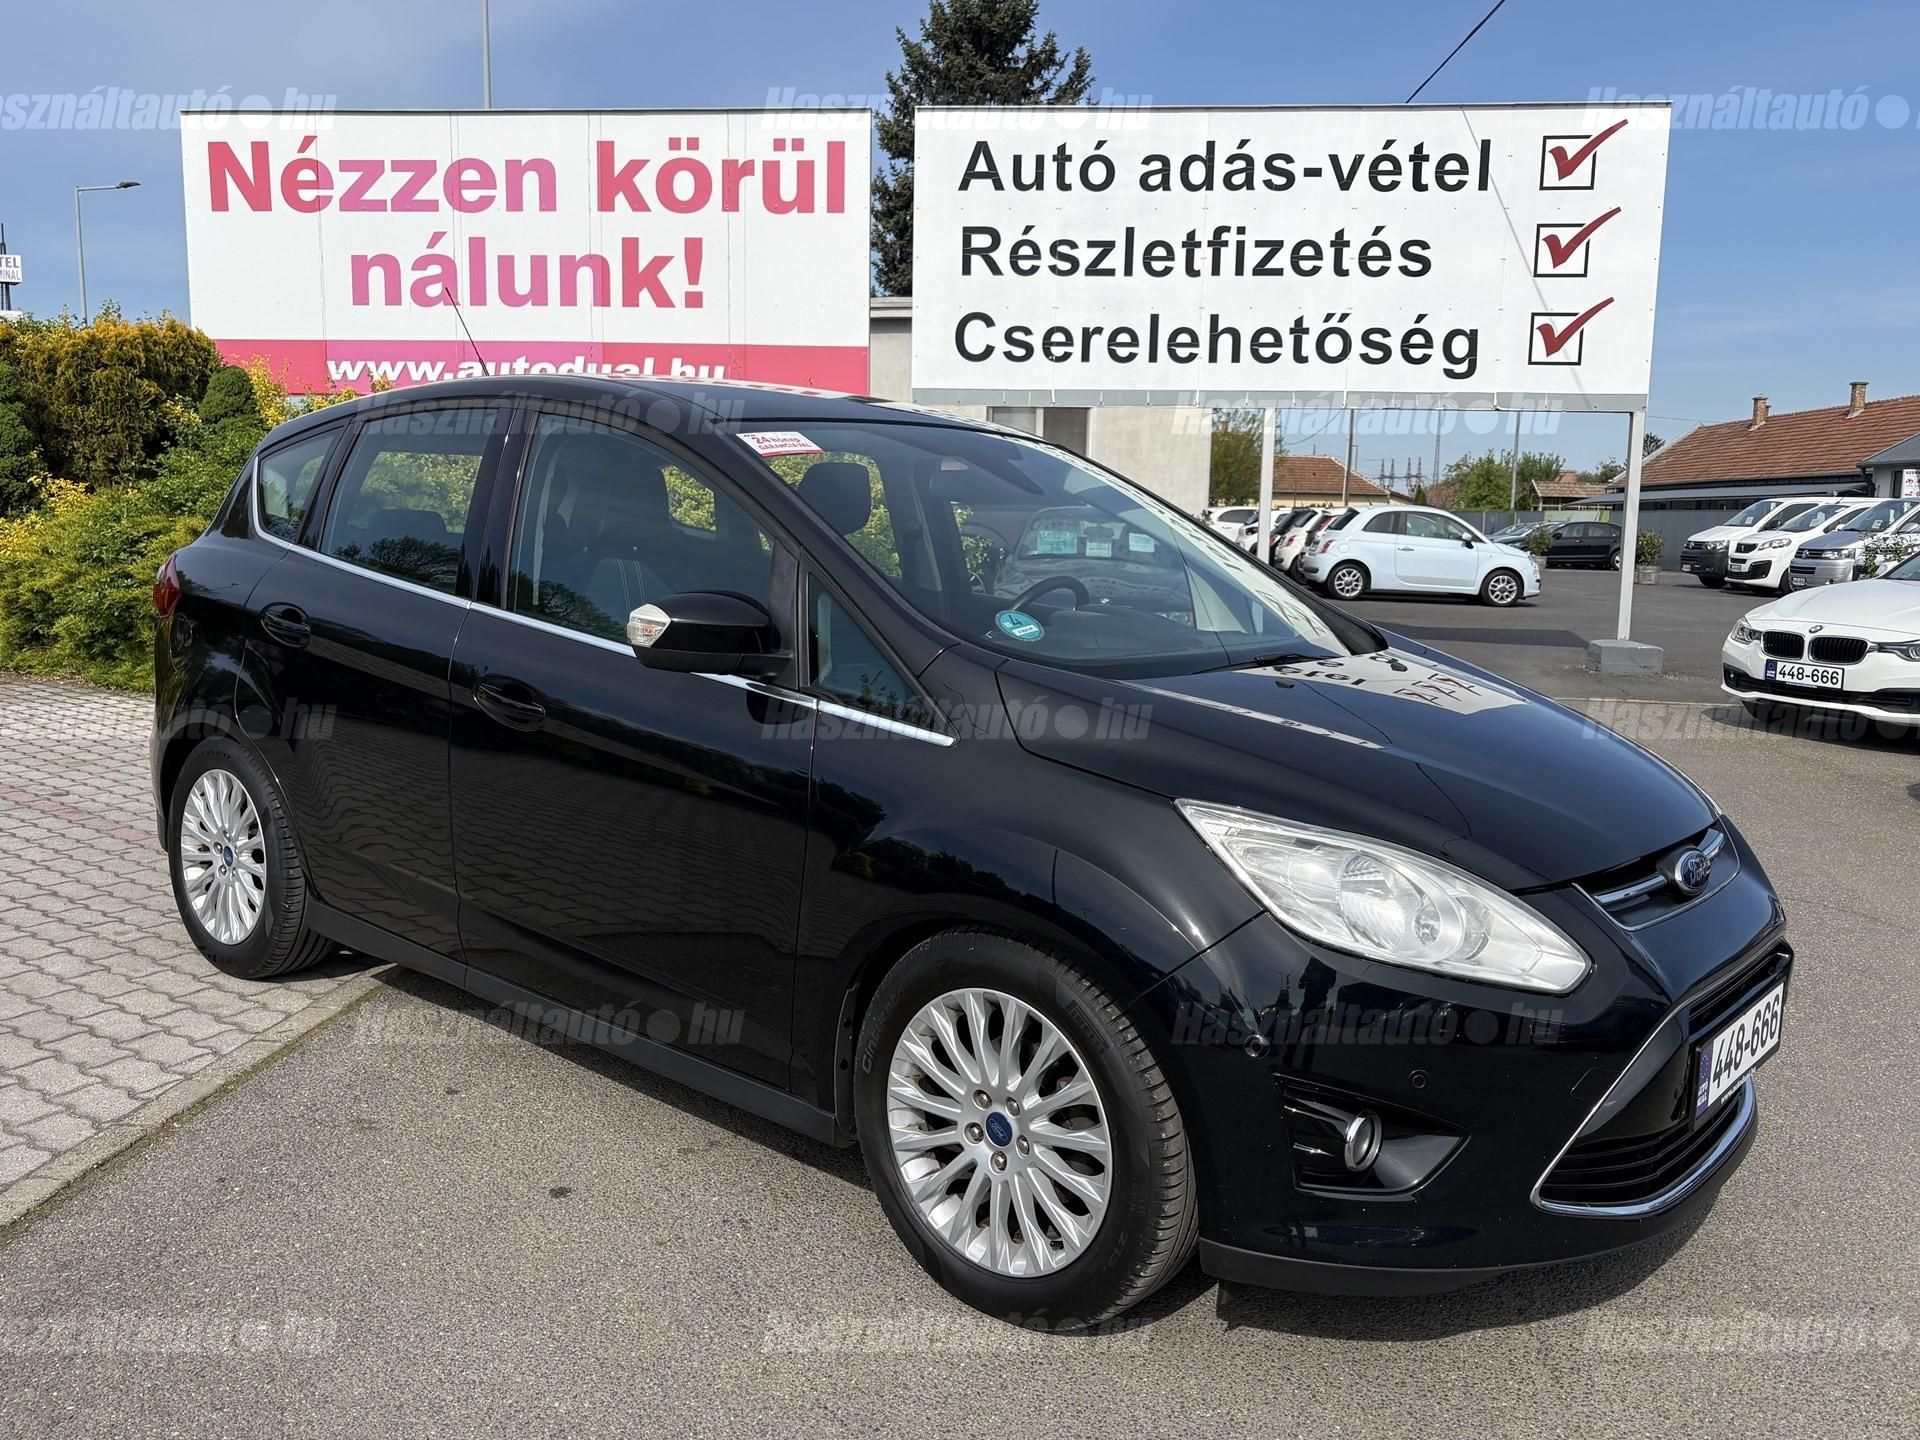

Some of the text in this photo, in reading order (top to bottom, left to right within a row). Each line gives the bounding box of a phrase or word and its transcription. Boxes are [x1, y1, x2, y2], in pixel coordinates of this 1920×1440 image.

[208, 136, 844, 214] Nézzen körül
[959, 139, 1490, 192] Autó adás-vétel
[352, 233, 702, 308] nálunk!
[962, 226, 1431, 277] Részletfizetés
[327, 355, 724, 382] www.autodualhu
[956, 312, 1478, 379] Cserelehetőség
[1779, 665, 1839, 685] 448-666
[1713, 993, 1780, 1089] 448-666
